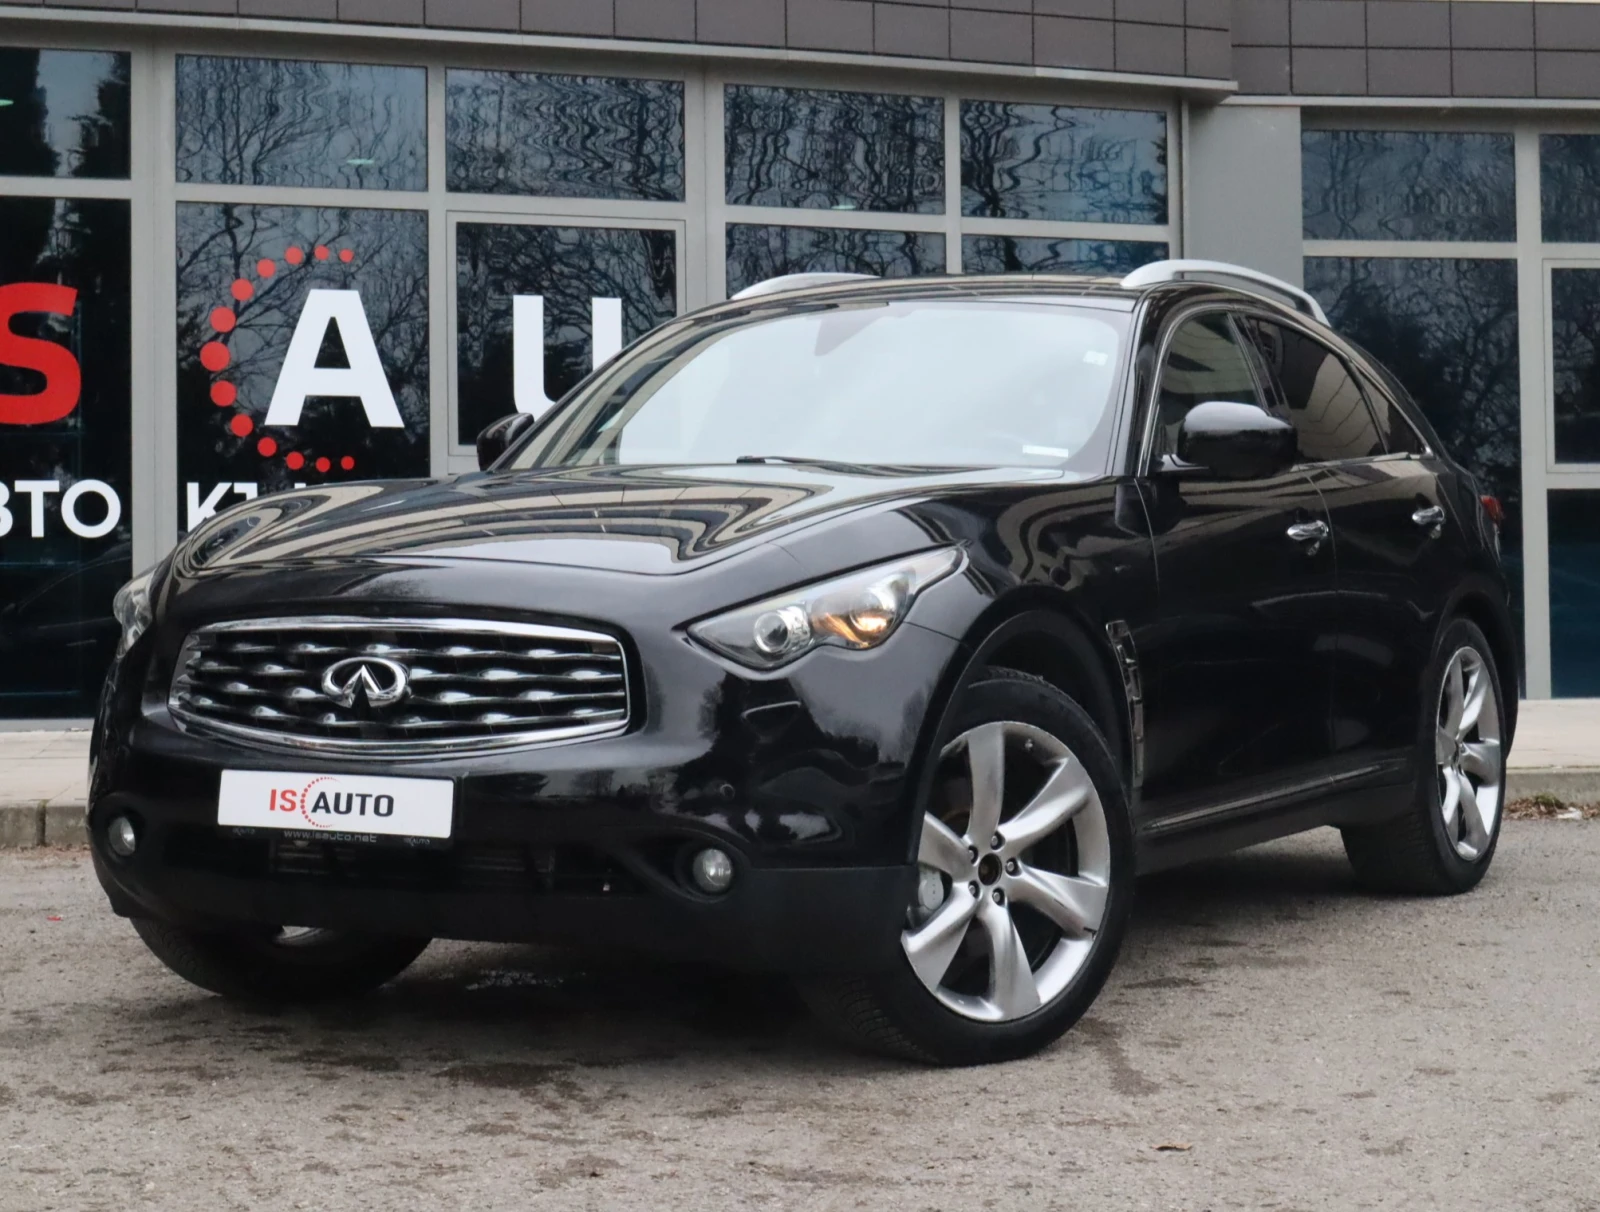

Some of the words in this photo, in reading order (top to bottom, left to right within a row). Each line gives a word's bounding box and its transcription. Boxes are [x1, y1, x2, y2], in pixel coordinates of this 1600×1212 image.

[269, 789, 297, 812] IS
[311, 791, 394, 817] AUTO
[283, 829, 377, 843] www.isauto.net
